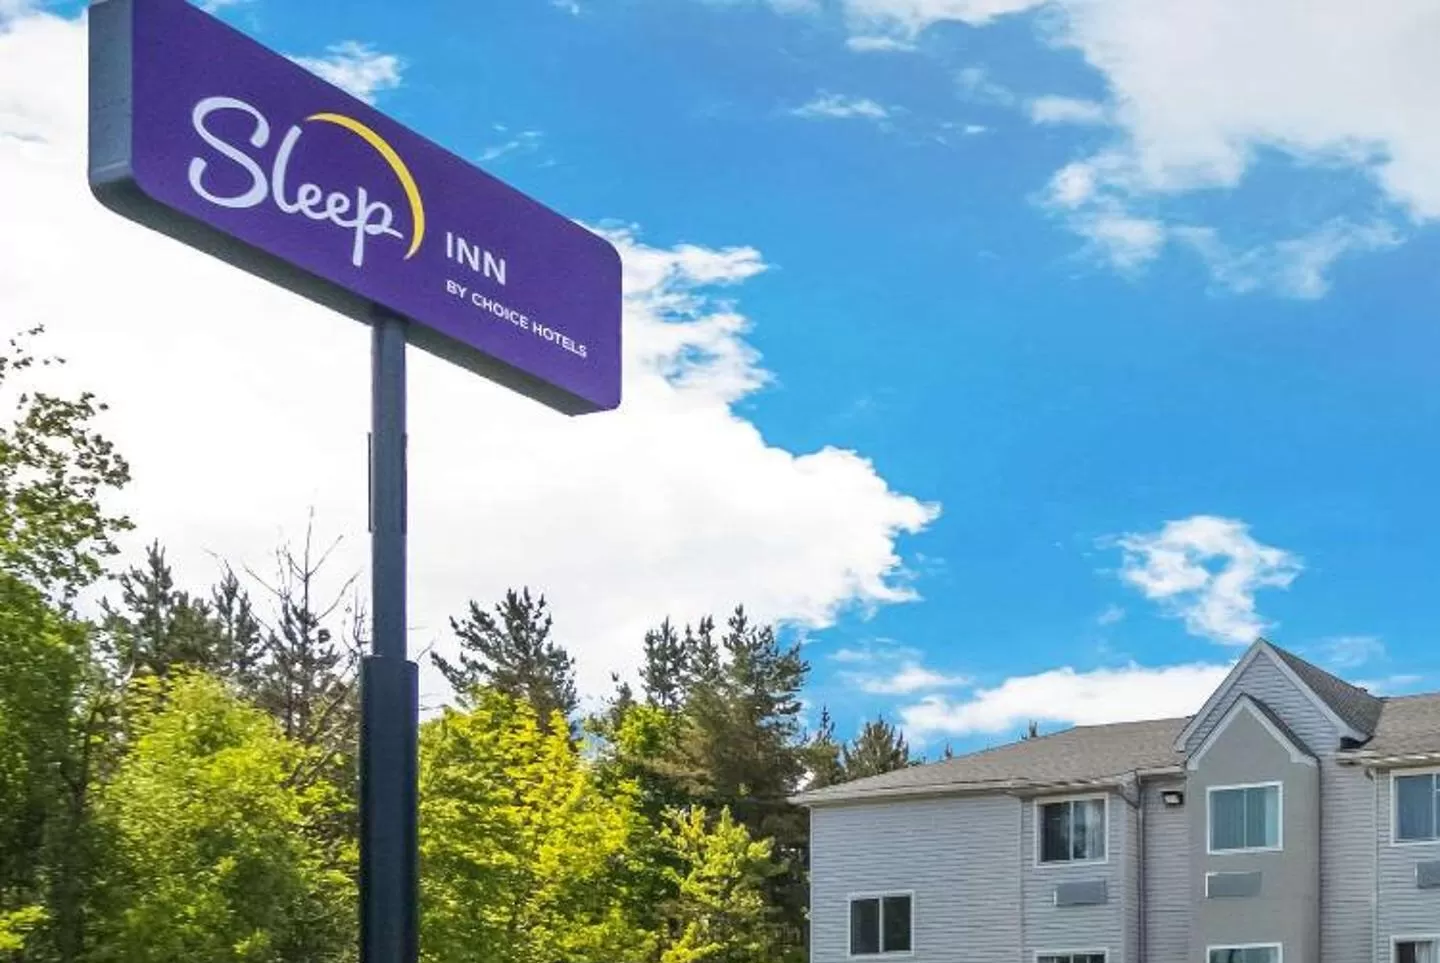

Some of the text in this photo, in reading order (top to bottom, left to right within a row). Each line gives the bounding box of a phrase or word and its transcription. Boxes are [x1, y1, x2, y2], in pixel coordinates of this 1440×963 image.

[188, 97, 506, 286] Sleep INN
[446, 279, 587, 358] BY CHOICE HOTELS
